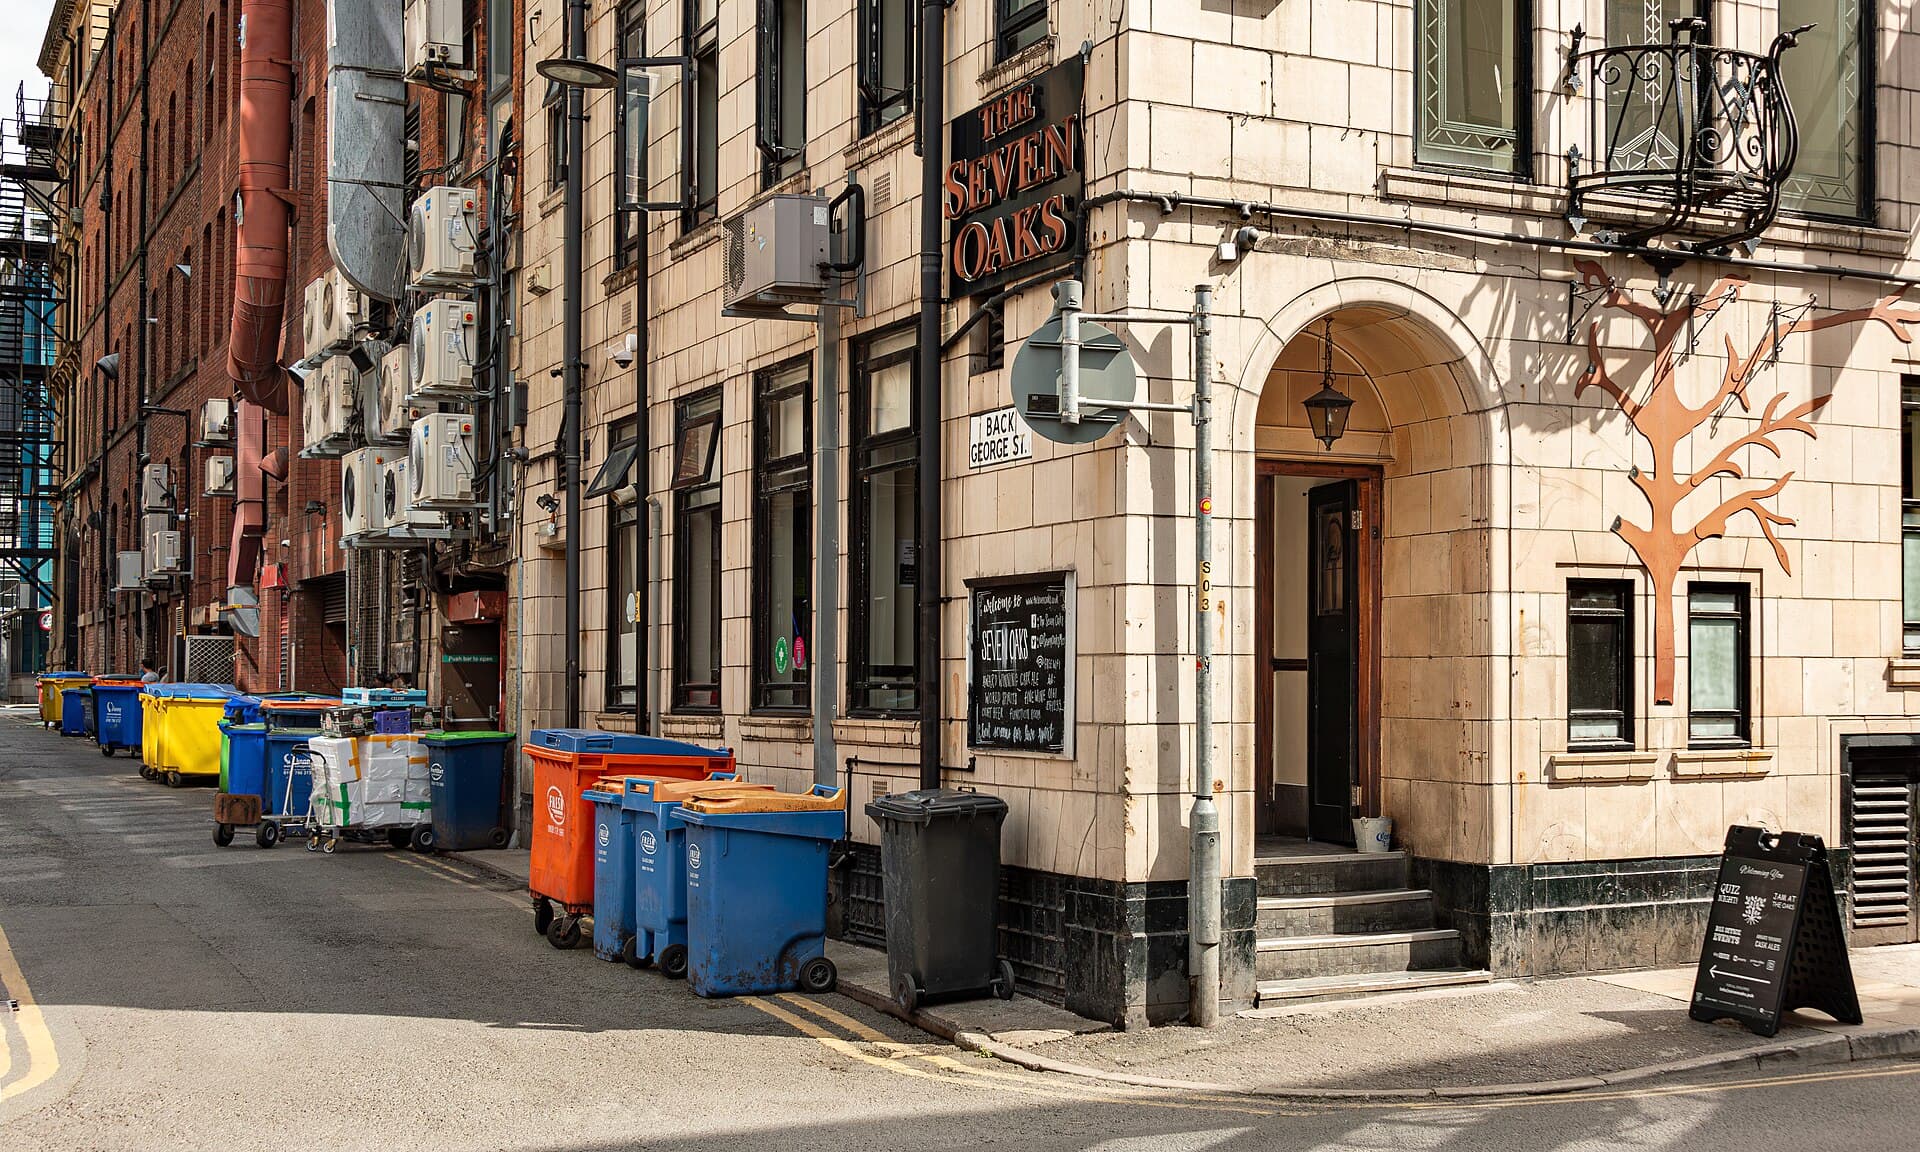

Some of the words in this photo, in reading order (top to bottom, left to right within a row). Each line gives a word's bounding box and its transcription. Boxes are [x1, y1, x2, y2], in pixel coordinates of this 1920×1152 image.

[978, 84, 1036, 142] THE
[944, 114, 1078, 220] SEVEN
[954, 194, 1067, 282] OAKS
[986, 411, 1015, 437] BACK
[971, 437, 1009, 463] GEORGE
[981, 629, 1007, 661] SEVEN
[1009, 628, 1028, 661] OAKS
[1720, 883, 1741, 896] QUIZ
[1712, 932, 1741, 946] EVENTS
